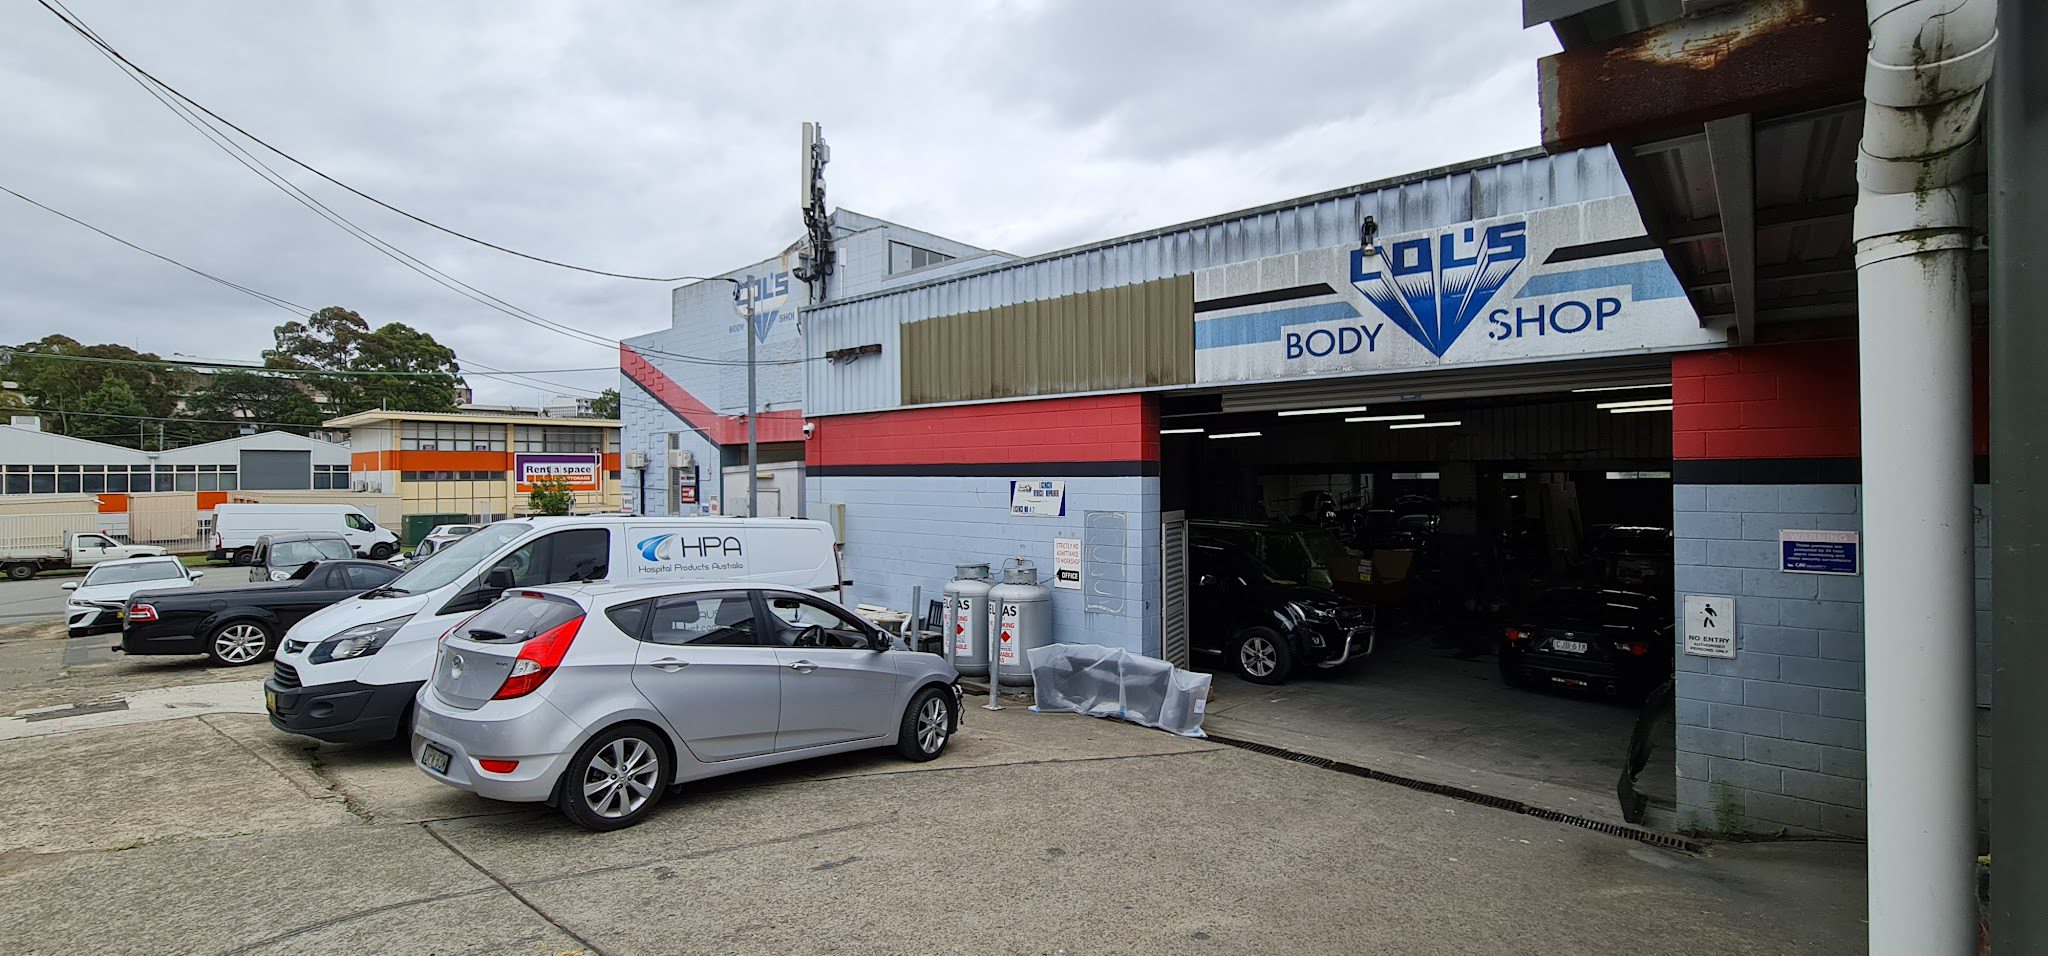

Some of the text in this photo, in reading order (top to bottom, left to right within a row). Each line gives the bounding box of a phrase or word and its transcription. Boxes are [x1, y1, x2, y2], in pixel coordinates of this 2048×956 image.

[1350, 221, 1526, 284] COL'S
[1286, 297, 1622, 360] BODY SHOP
[526, 465, 552, 474] Rent
[563, 466, 592, 475] space
[681, 536, 742, 558] HPA
[638, 562, 744, 575] Hospital Products Australia
[1061, 571, 1079, 580] OFFICE
